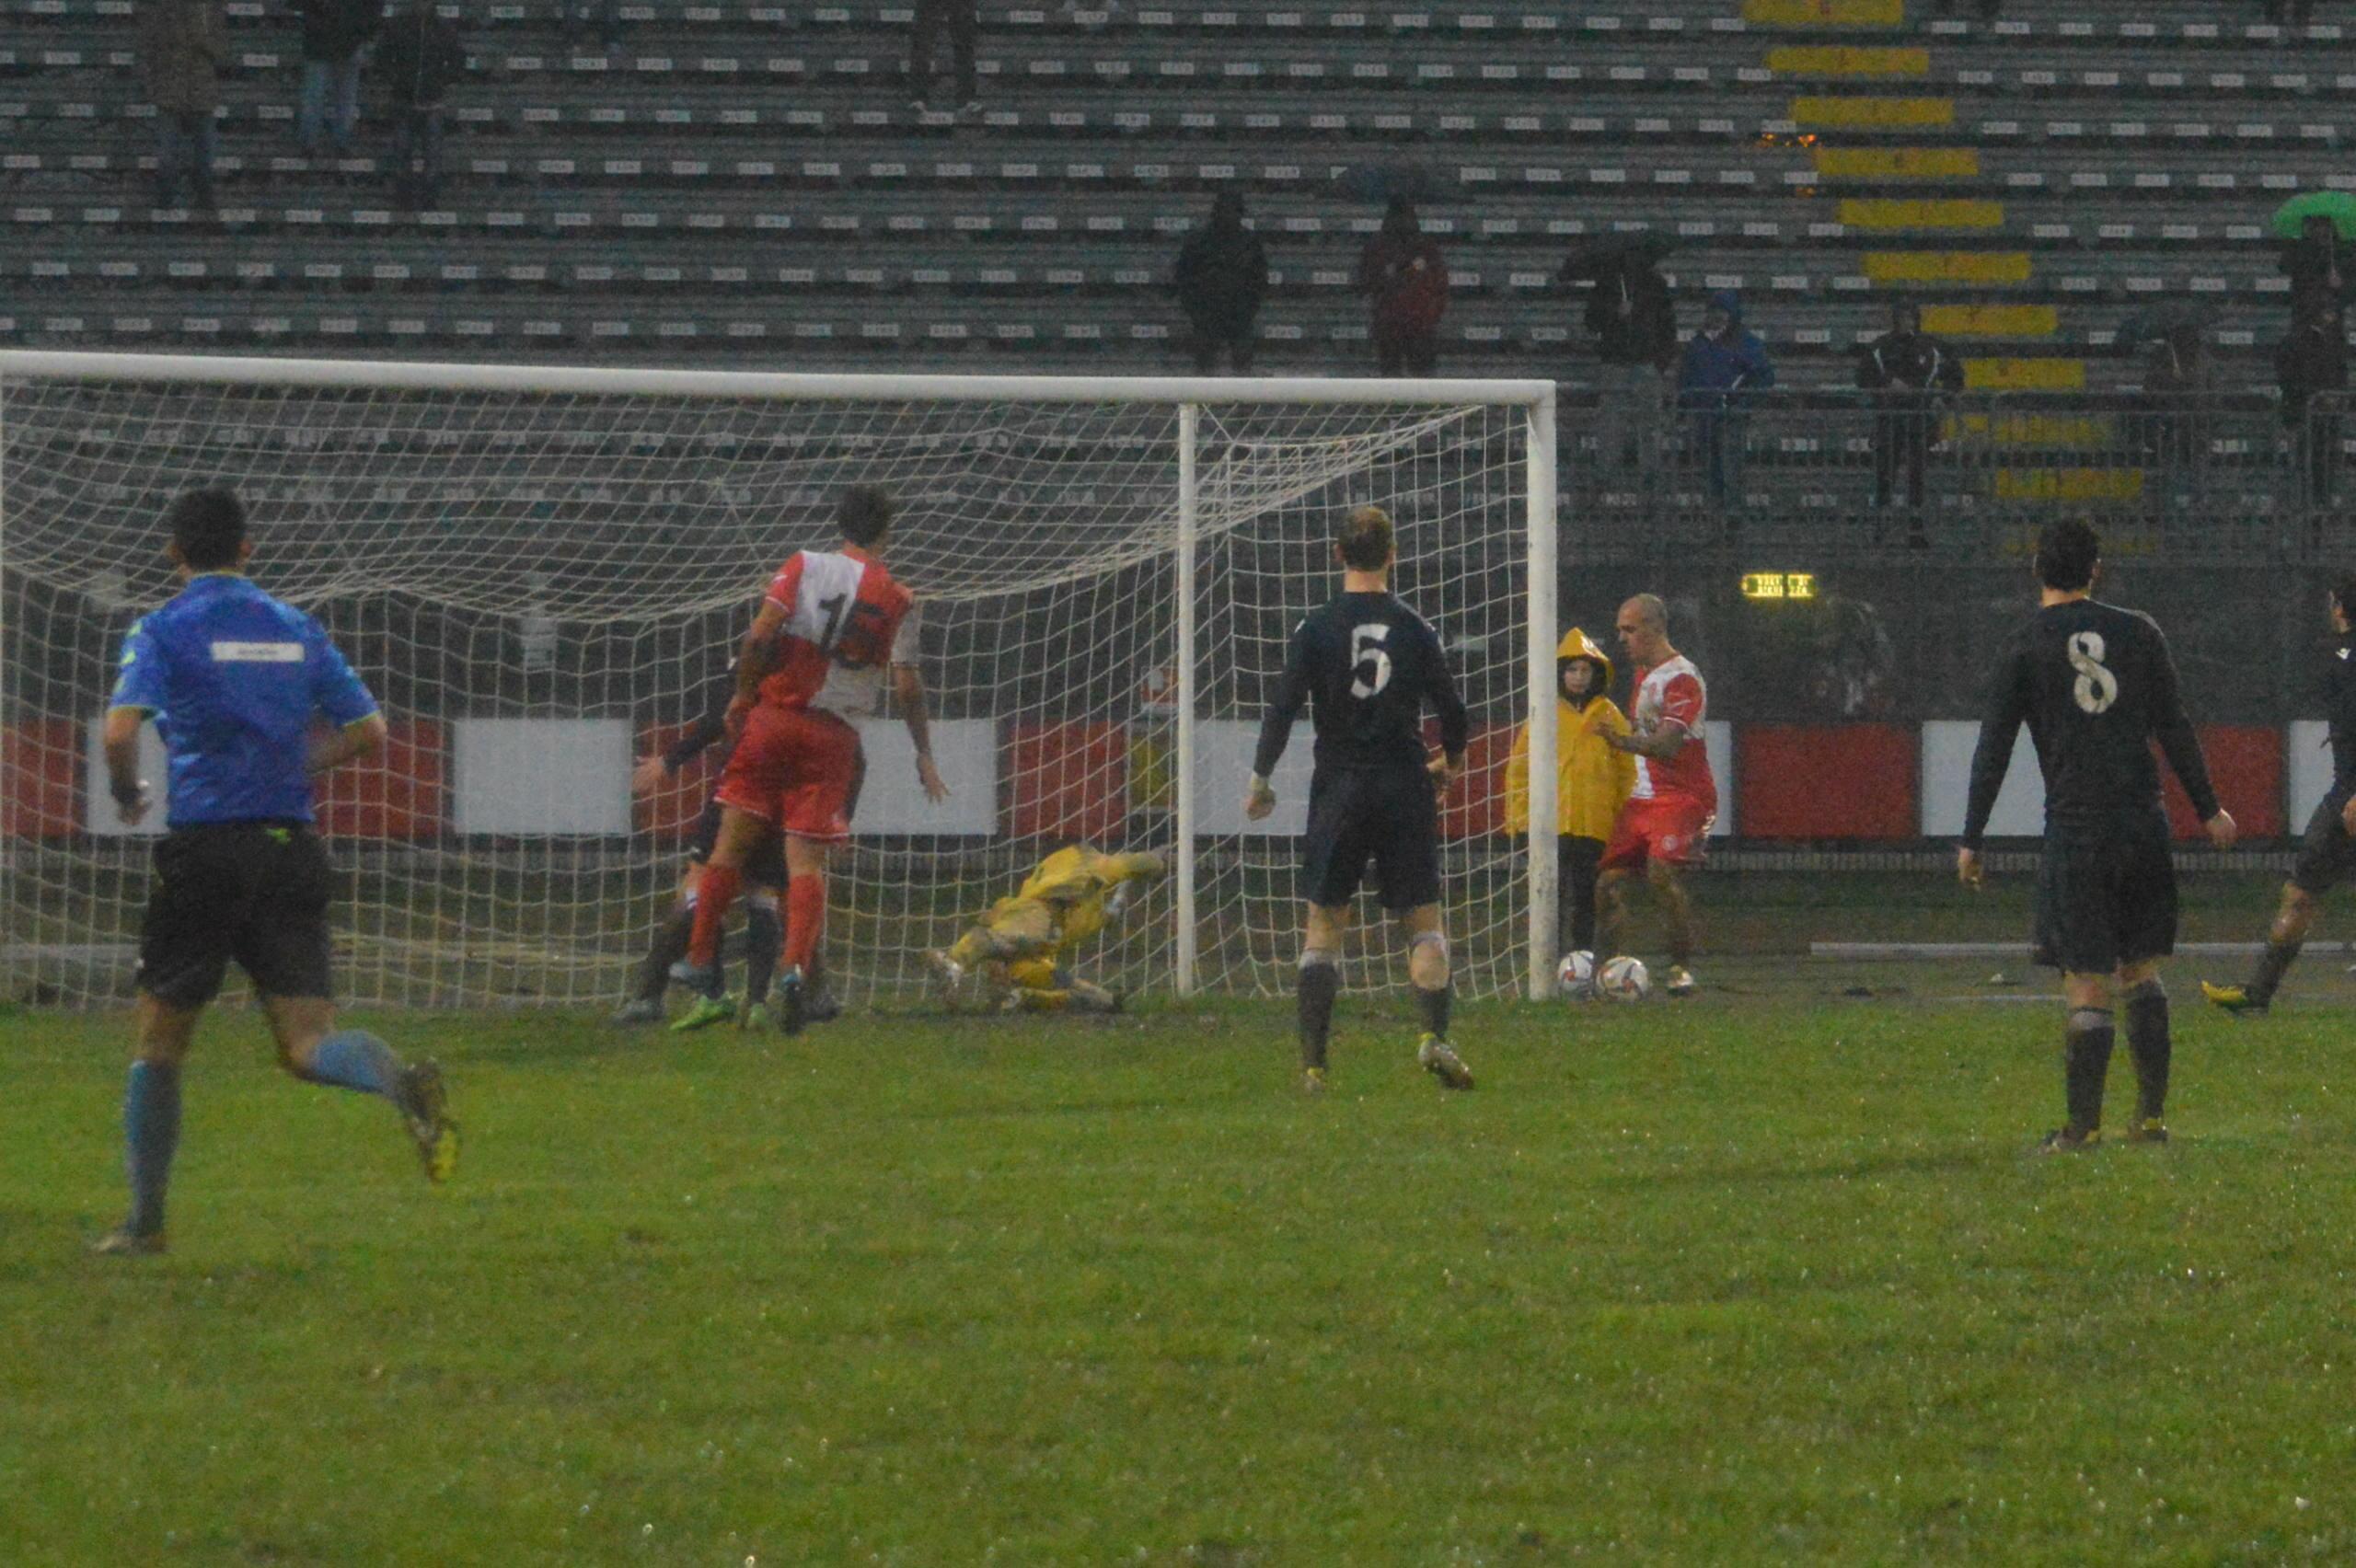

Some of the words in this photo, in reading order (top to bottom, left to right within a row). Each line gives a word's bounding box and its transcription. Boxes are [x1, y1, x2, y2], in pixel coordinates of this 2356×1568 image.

[818, 593, 884, 671] 15
[1350, 623, 1392, 699] 5
[2068, 631, 2118, 713] 8
